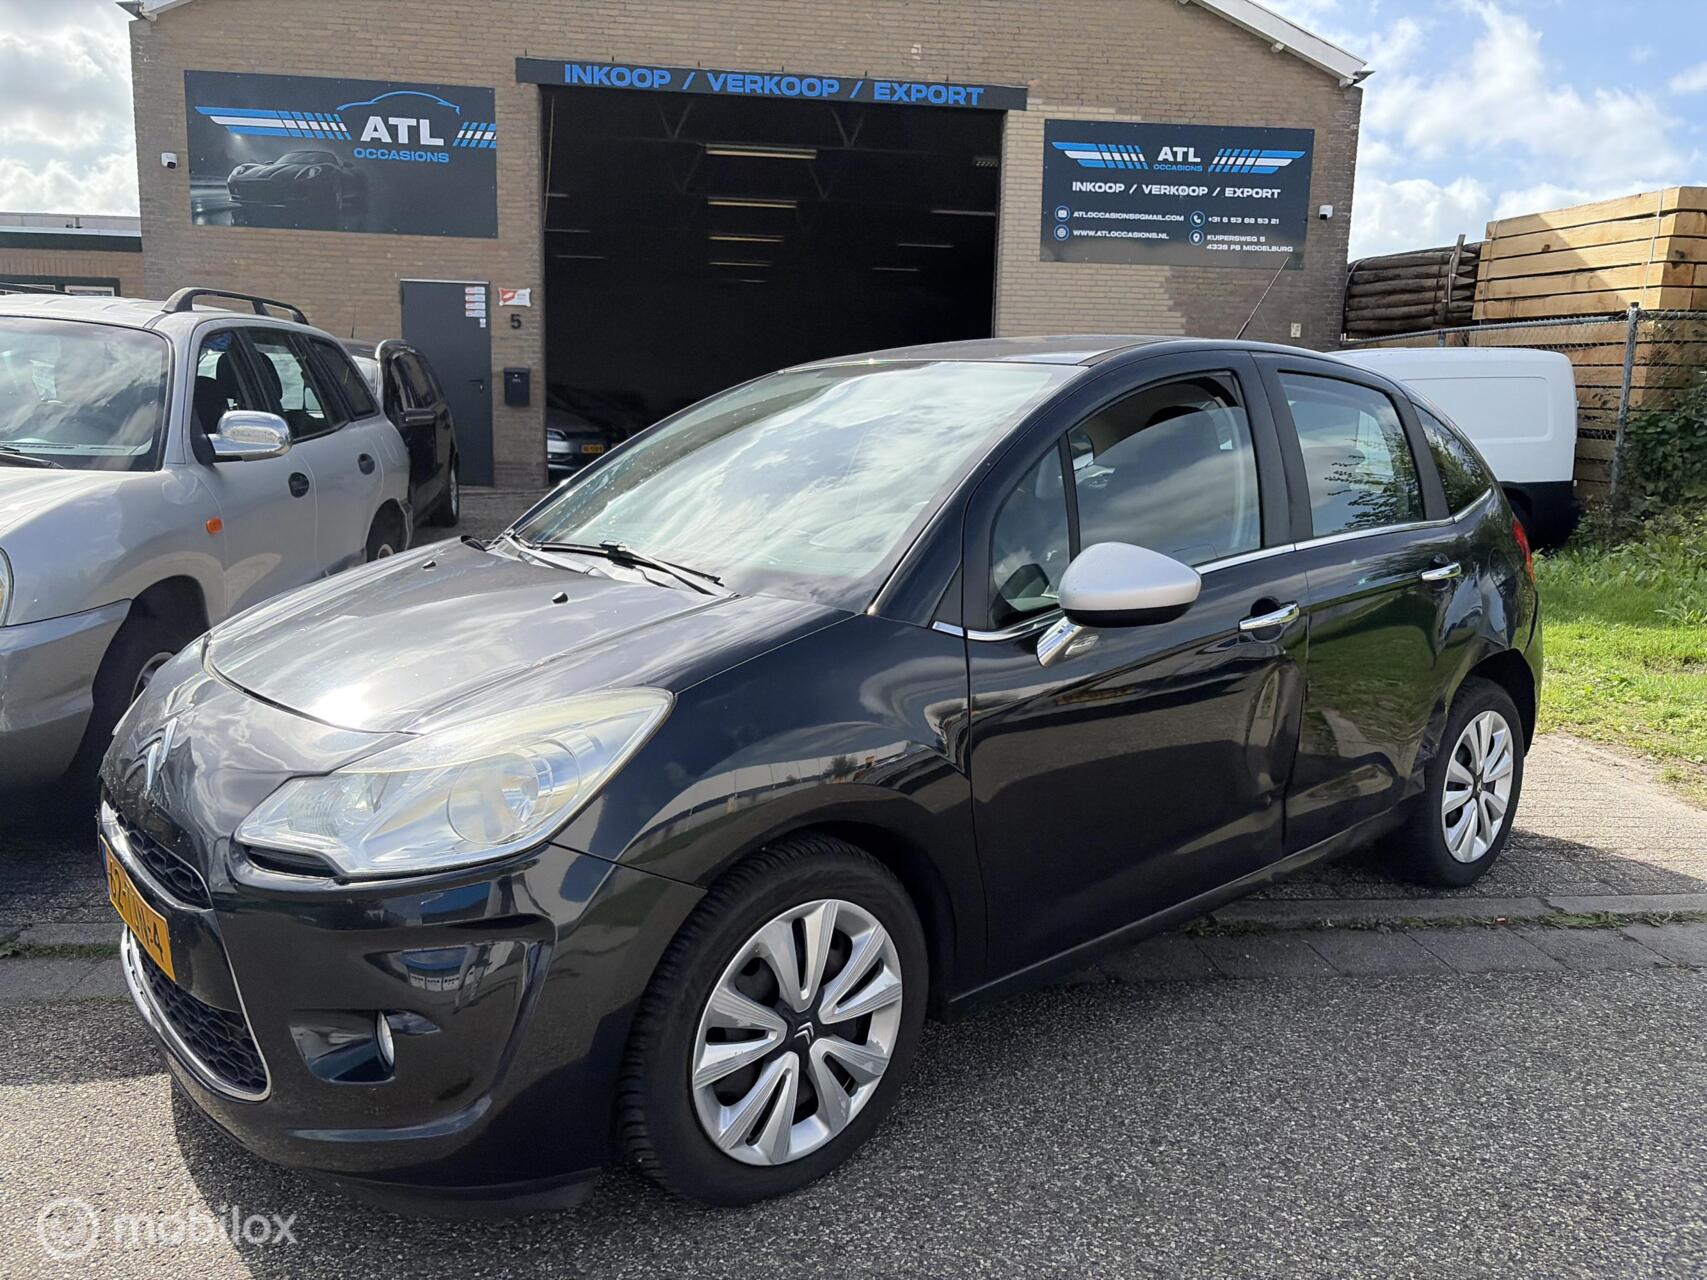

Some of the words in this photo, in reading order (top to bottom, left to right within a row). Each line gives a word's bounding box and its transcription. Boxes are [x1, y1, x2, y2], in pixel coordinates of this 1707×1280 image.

[564, 63, 671, 88] INKOOP
[682, 71, 696, 90] /
[706, 72, 840, 97] VERKOOP
[849, 79, 863, 98] /
[874, 81, 984, 106] EXPORT
[360, 116, 445, 146] ATL
[353, 147, 450, 163] OCCASIONS
[1157, 146, 1201, 162] ATL
[1153, 163, 1203, 172] OCCASIONS
[1072, 181, 1125, 193] INKOOP
[1129, 184, 1138, 194] /
[1142, 184, 1208, 196] VERKOOP
[1212, 187, 1221, 197] /
[1224, 187, 1281, 199] EXPORT
[1073, 229, 1170, 239] WWW.ATLOCCASIONS.NL
[511, 314, 521, 329] 5
